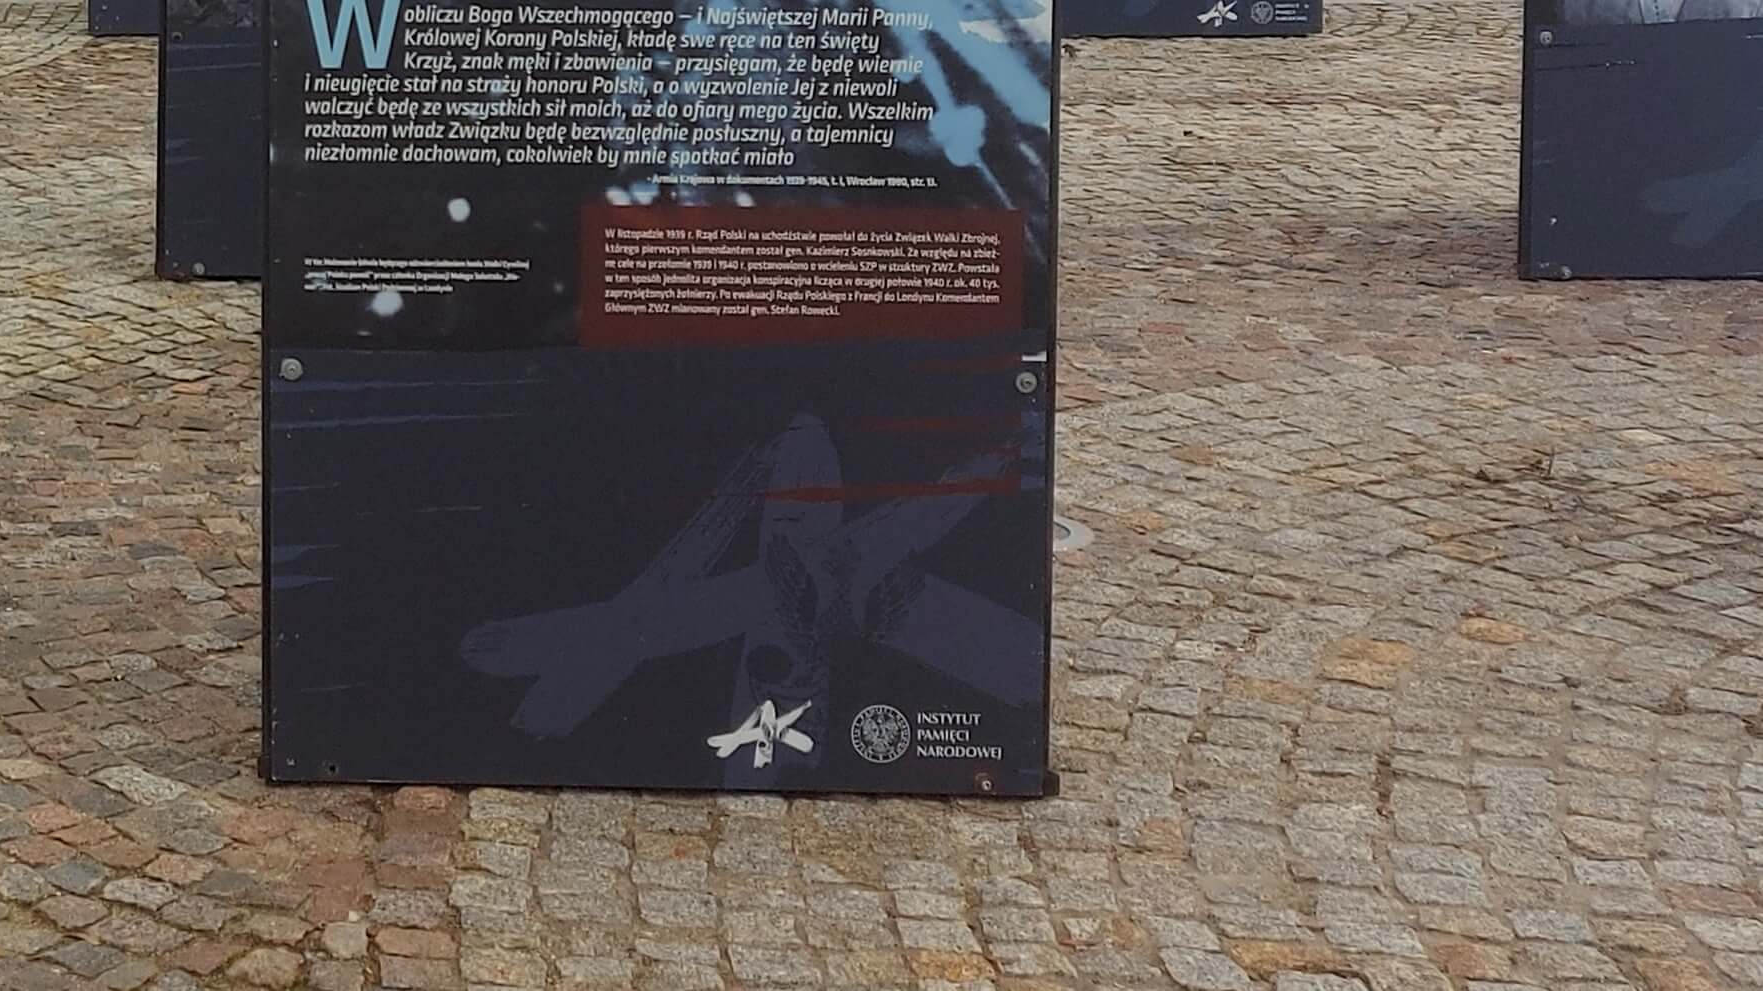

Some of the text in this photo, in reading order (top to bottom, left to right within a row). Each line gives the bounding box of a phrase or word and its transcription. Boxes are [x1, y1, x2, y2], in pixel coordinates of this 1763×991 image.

[403, 4, 464, 23] obliczu
[468, 5, 514, 27] Boga
[518, 5, 674, 30] Wszechmogącego
[696, 6, 704, 24] i
[707, 6, 818, 30] Najświętszej
[822, 7, 869, 27] Marii
[871, 8, 934, 29] Panny,
[404, 27, 880, 54] Królowej Korony Polskiej, kładę swe ręce na ten święty
[404, 50, 922, 77] Krzyż, znak męki i zbawienia przysięgam, że będę wiernie
[304, 72, 898, 100] i nieugięcie stał na straży honoru Polski, a o wyzwolenie Jej z niewoli
[304, 96, 934, 123] walczyć będę ze wszystkich sił moich, aż do ofiary mego życia. Wszelkim
[304, 119, 894, 148] rozkazom władz Związku będę bezwzględnie posłuszny, a tajemnicy
[305, 142, 795, 168] niezłomnie dochowam, cokolwiek by mnie spotkać miało
[917, 711, 981, 725] INSTYTUT
[917, 729, 970, 744] PAMIĘCI
[917, 745, 1002, 760] NARODOWEJ
